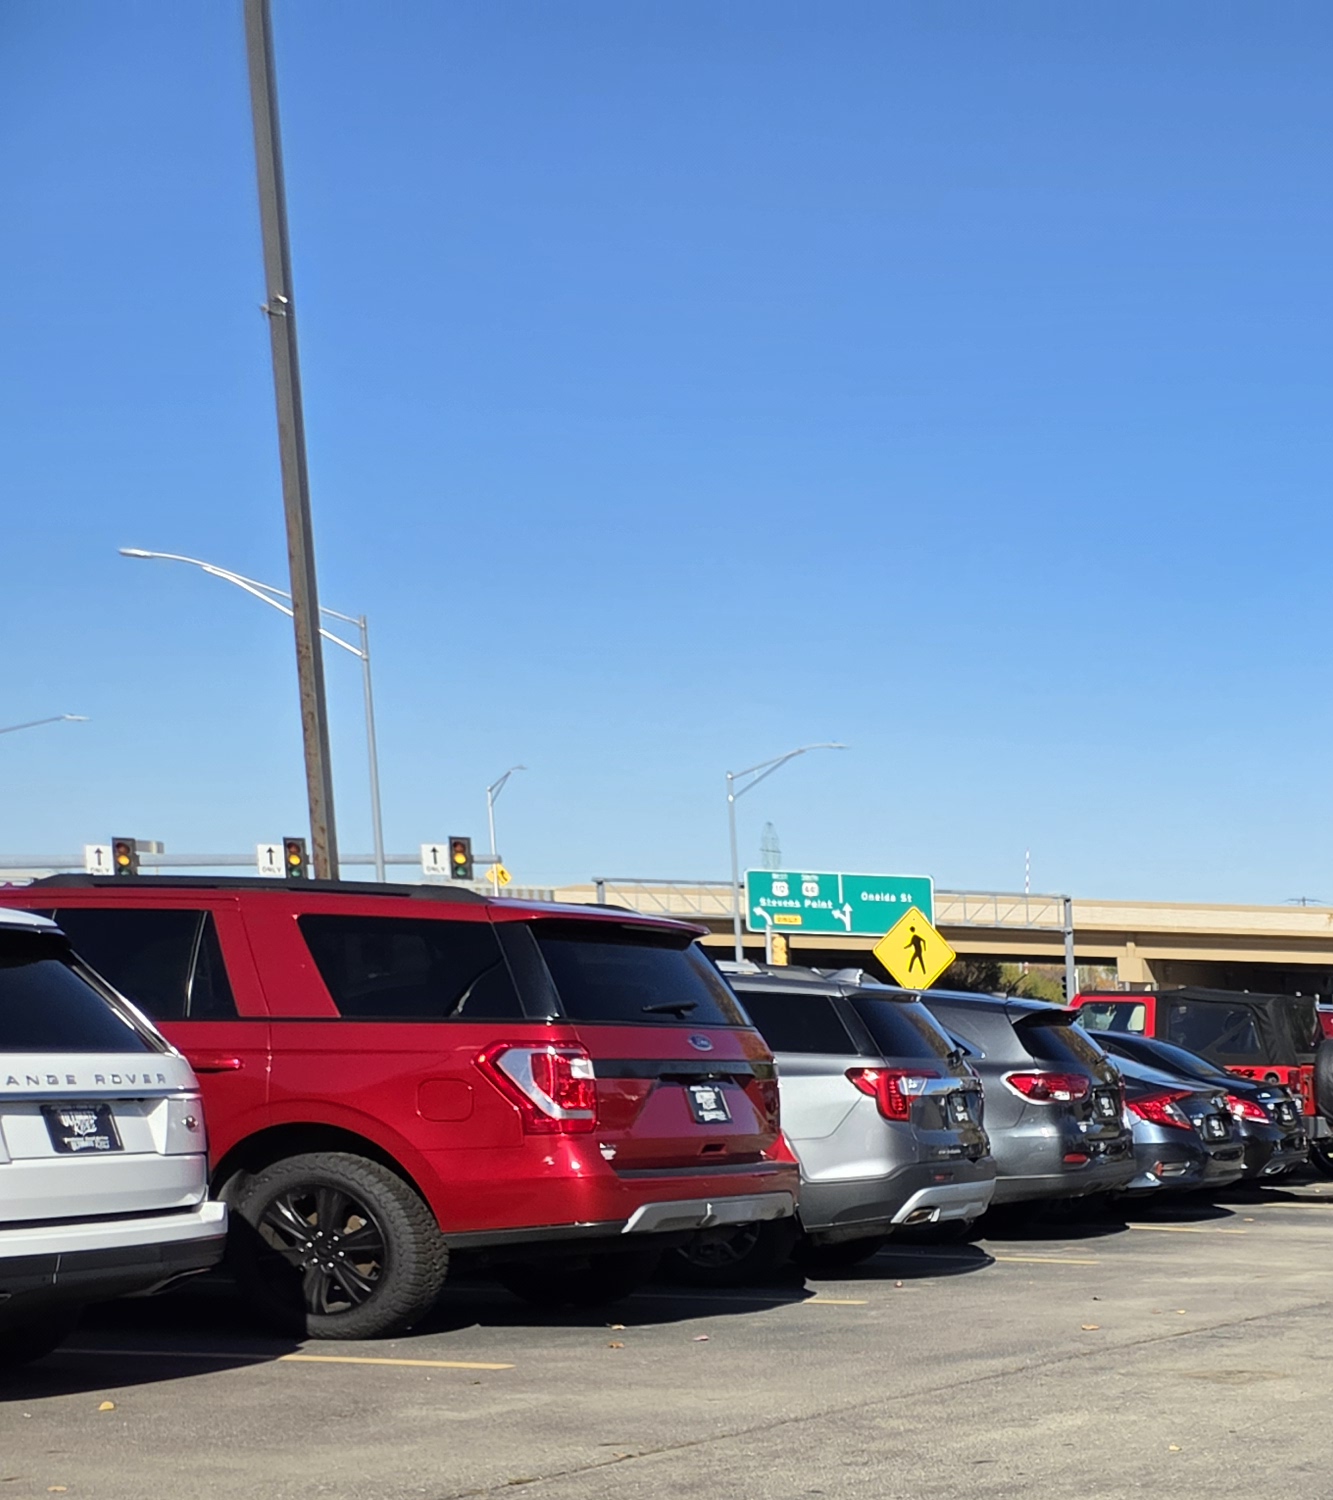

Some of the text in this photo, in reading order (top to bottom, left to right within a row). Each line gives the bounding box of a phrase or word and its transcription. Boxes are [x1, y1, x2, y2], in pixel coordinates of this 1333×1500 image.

[759, 897, 833, 909] Stevens Point
[861, 892, 912, 903] Oneida St
[95, 1073, 166, 1084] ROVER
